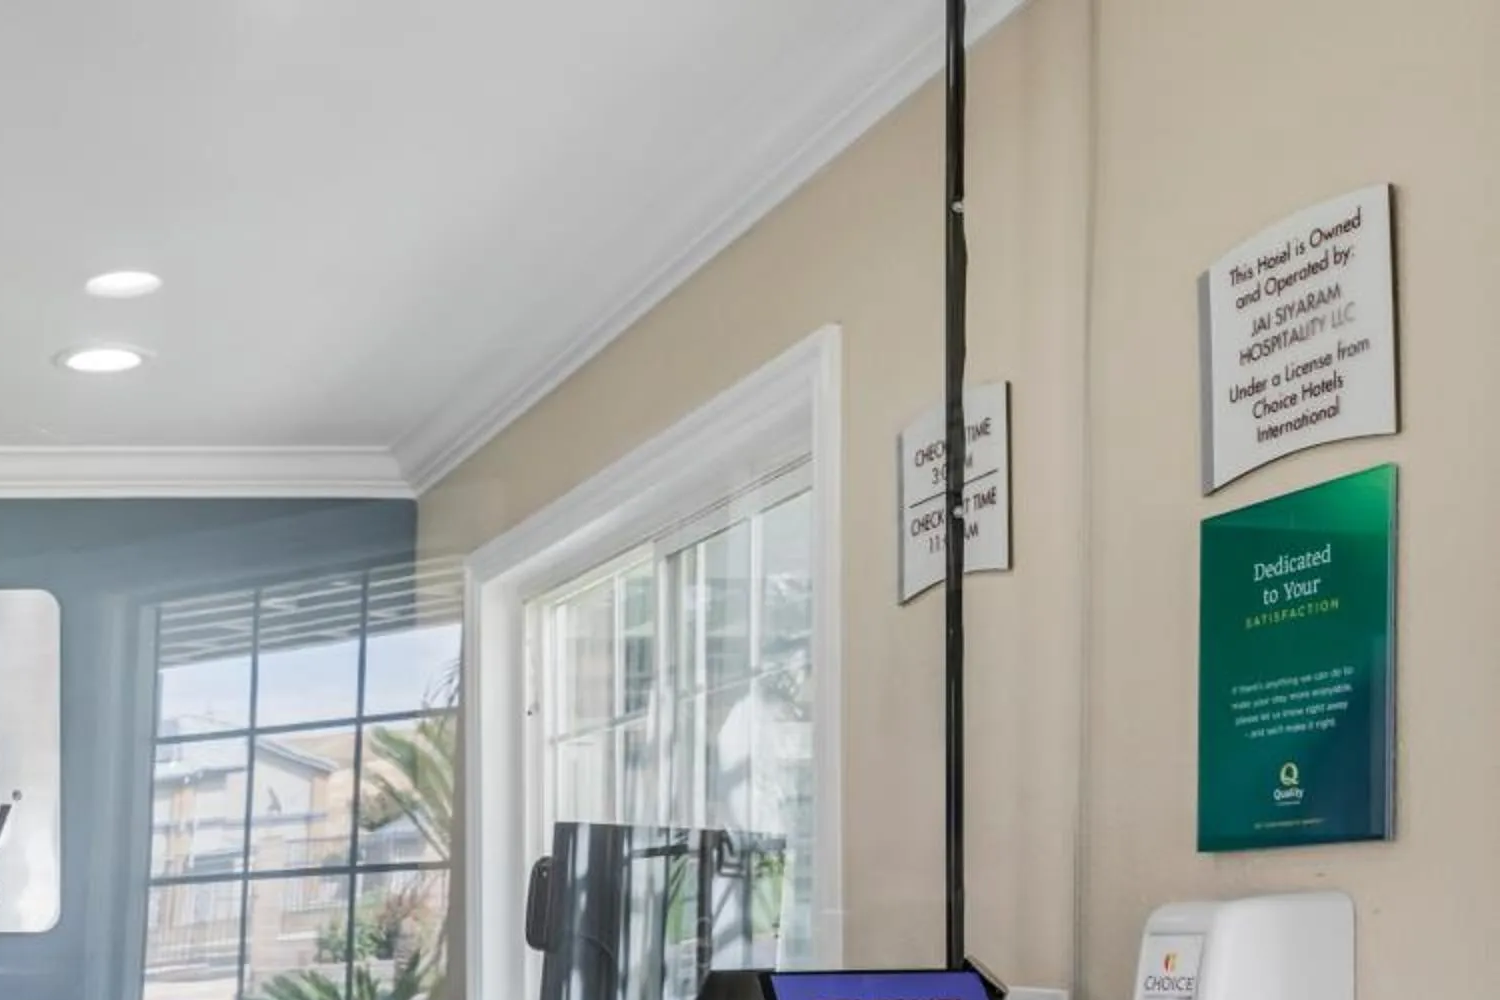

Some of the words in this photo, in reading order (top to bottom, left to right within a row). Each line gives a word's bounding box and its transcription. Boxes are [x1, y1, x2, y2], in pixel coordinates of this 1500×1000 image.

[1228, 263, 1254, 287] This
[1257, 241, 1290, 275] Hotel
[1295, 237, 1306, 256] is
[1309, 204, 1362, 249] Owned
[1235, 282, 1261, 310] and
[1264, 248, 1329, 297] Operated
[1251, 312, 1271, 338] JAI
[1274, 282, 1341, 326] SIYARAM
[1239, 314, 1326, 366] HOSPITALITY
[1331, 301, 1356, 329] LLC
[1229, 376, 1268, 404] Under
[1271, 373, 1281, 387] a
[1284, 353, 1333, 382] License
[1337, 338, 1371, 361] from
[1251, 393, 1297, 419] Choice
[1301, 369, 1345, 401] Hotels
[964, 416, 992, 445] TIME
[1257, 395, 1341, 443] International
[973, 486, 998, 512] TIME
[1253, 543, 1332, 582] Dedicated
[1263, 588, 1279, 605] to
[1283, 578, 1322, 601] Your
[1244, 598, 1340, 630] SATISFACTION
[1280, 761, 1299, 786] Q
[1143, 975, 1195, 991] CHOICE
